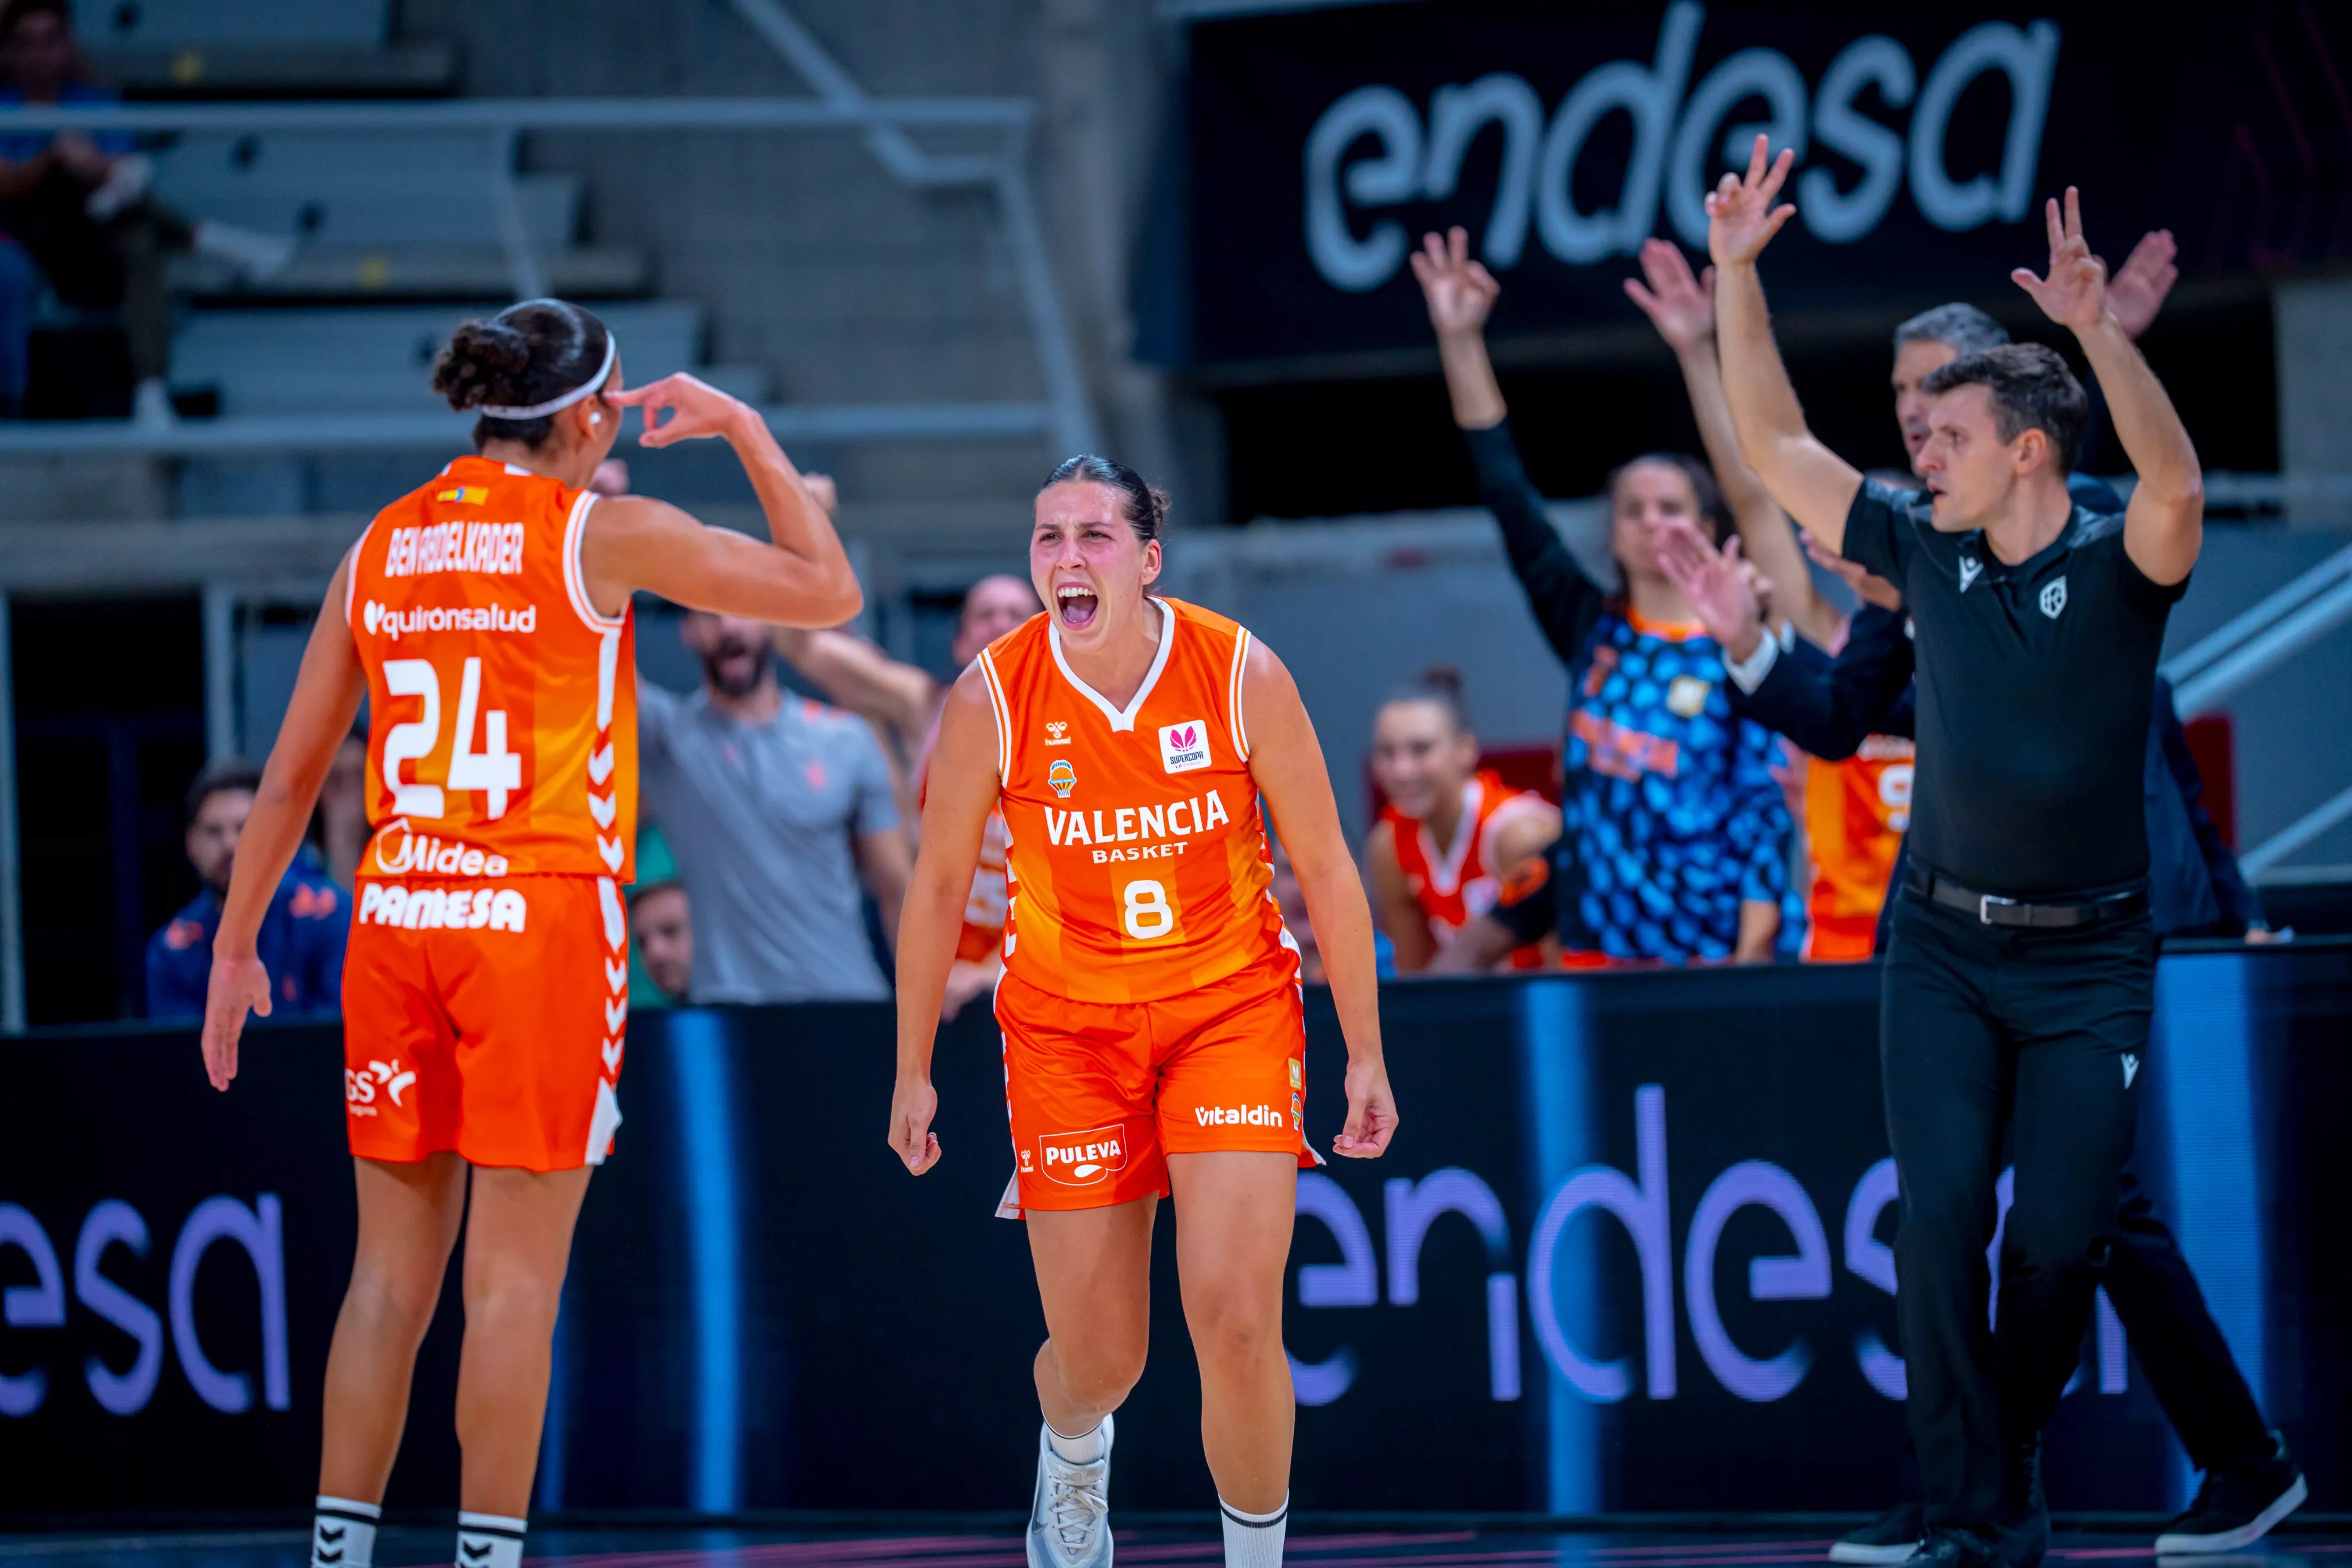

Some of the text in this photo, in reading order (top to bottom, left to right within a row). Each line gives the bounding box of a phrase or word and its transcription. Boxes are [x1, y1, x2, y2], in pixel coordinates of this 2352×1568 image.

[1304, 1, 2060, 291] endesa
[382, 657, 521, 820] 24
[1170, 751, 1204, 764] SUPERCOPA
[1044, 789, 1230, 846] VALENCIA
[376, 818, 509, 877] Midea
[1092, 841, 1188, 864] BASKET
[359, 882, 527, 933] PAMESA
[1124, 879, 1174, 939] 8
[1046, 1140, 1121, 1166] PULEVA
